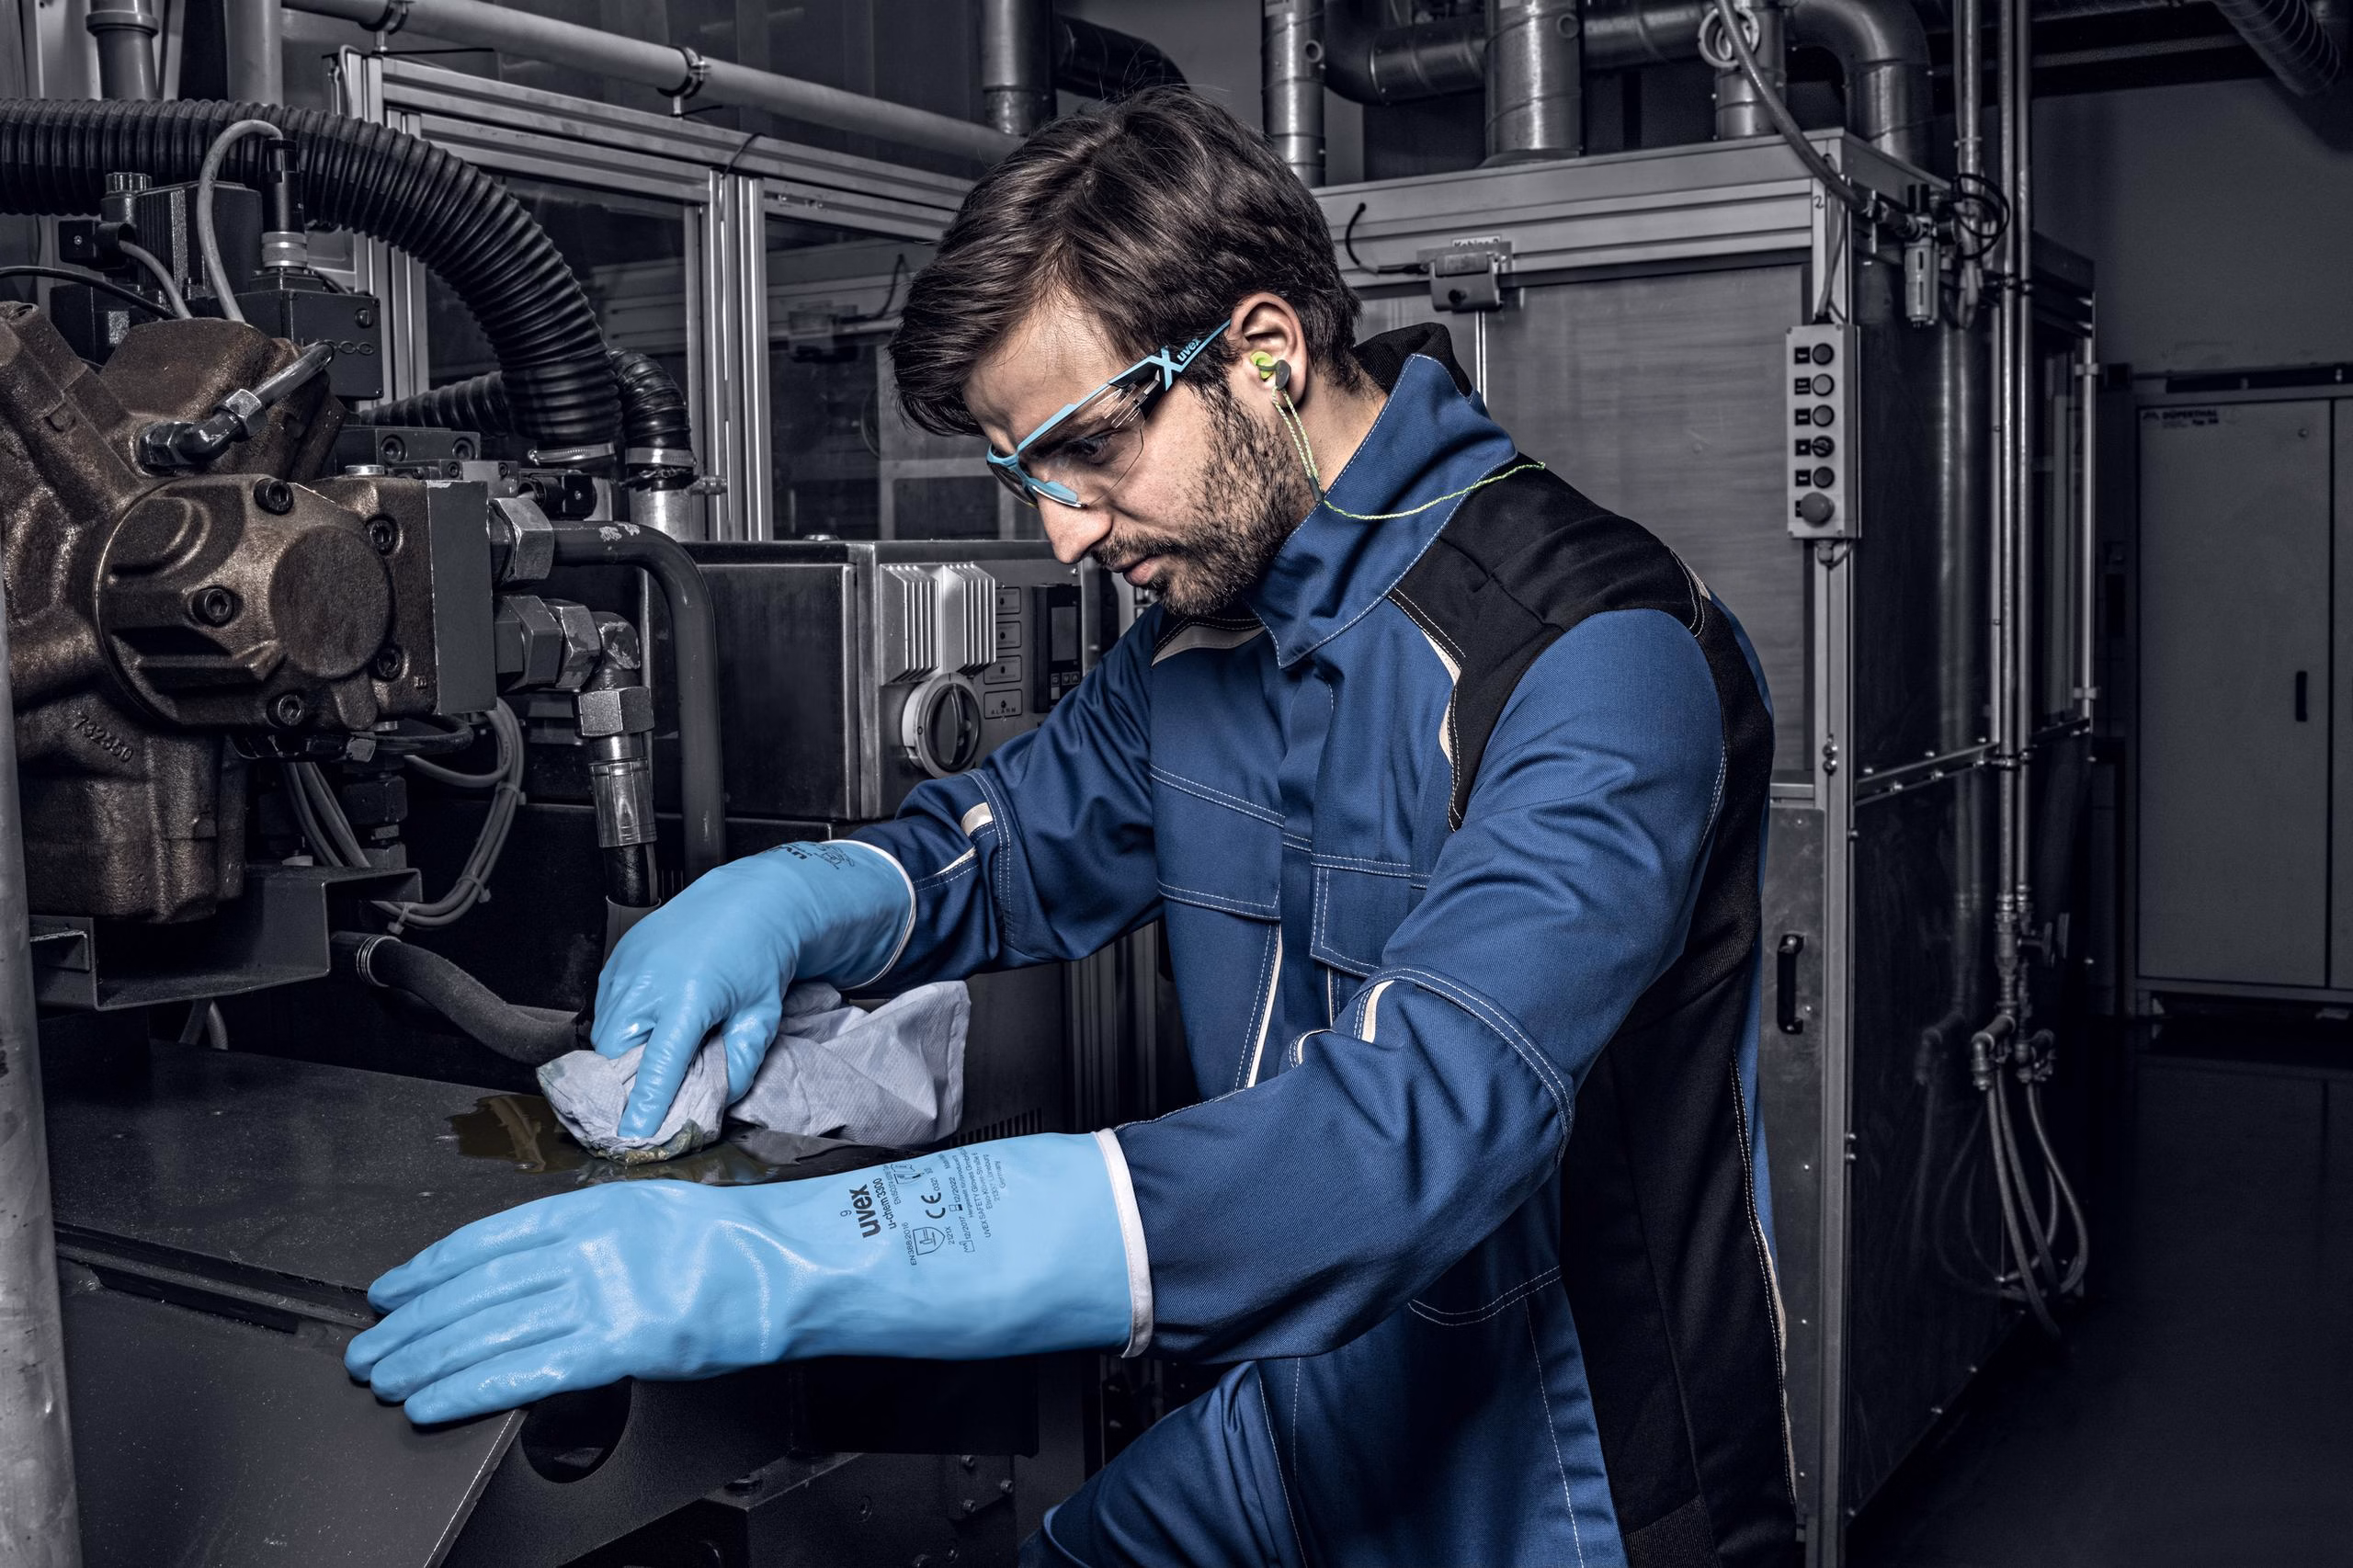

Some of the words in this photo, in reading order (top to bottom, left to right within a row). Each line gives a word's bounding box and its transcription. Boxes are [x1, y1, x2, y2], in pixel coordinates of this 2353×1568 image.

[1176, 338, 1202, 362] uvex
[872, 1177, 887, 1199] 3300
[949, 1176, 961, 1202] 12/2022
[968, 1172, 979, 1192] Gloves
[848, 1184, 881, 1238] uvex
[880, 1198, 897, 1230] u-chem
[973, 1194, 986, 1220] SAFETY
[959, 1216, 972, 1239] 12/2017
[981, 1220, 992, 1238] UVEX
